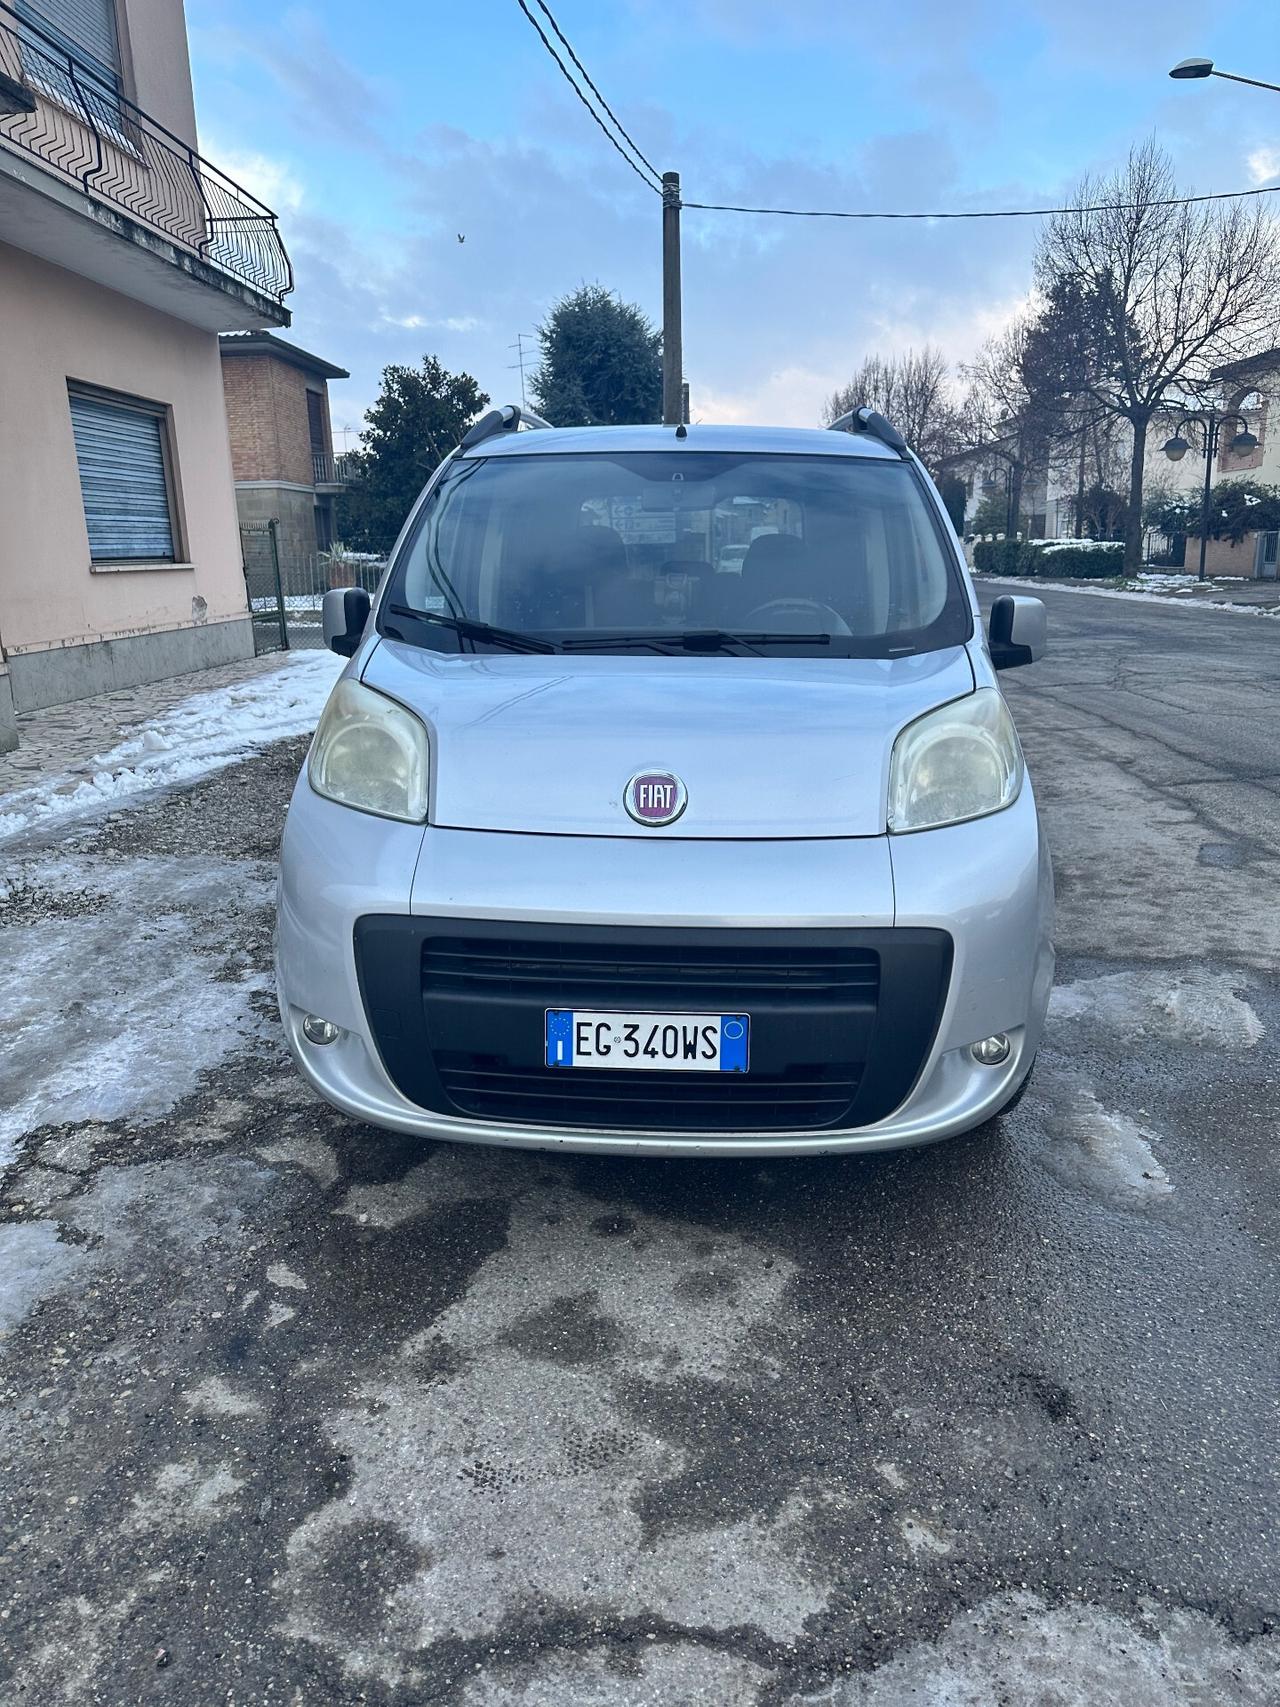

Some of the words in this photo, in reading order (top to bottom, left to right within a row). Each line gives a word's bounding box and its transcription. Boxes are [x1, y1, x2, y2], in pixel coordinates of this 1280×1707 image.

[639, 784, 674, 809] FIAT
[576, 1021, 612, 1057] EG
[623, 1023, 718, 1060] 340WS
